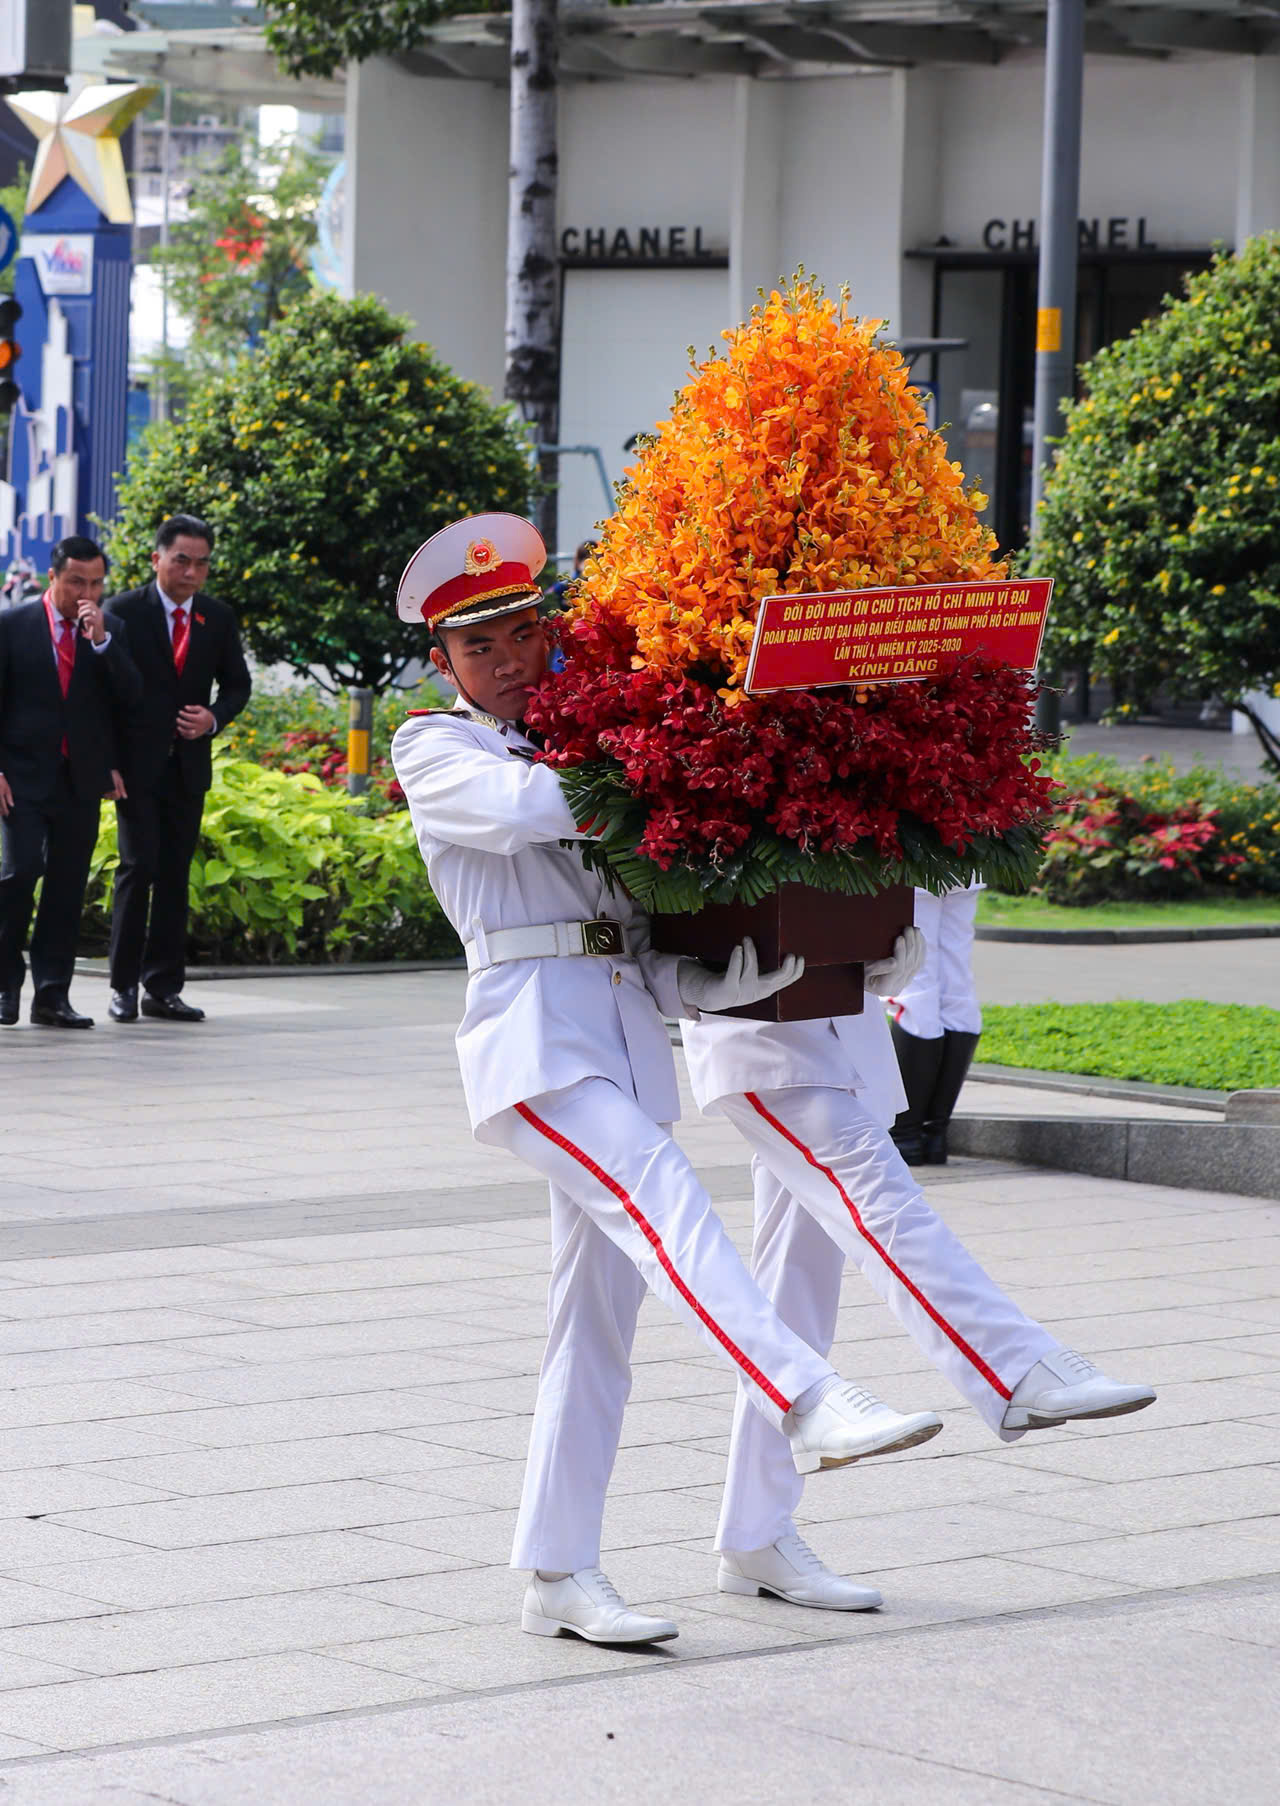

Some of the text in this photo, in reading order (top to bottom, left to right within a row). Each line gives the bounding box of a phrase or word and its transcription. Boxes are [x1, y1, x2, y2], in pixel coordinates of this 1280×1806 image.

[561, 226, 713, 257] CHANEL
[983, 217, 1157, 251] CHNEL
[783, 602, 804, 621] ĐỜI
[805, 600, 826, 620] ĐỜI
[826, 598, 853, 618] NHỚ
[853, 598, 870, 616] ƠN
[871, 593, 895, 615] CHỦ
[897, 596, 923, 616] TỊCH
[943, 590, 965, 609] CHÍ
[964, 591, 995, 608] MINH
[997, 587, 1011, 606] VĨ
[1010, 589, 1031, 608] ĐẠI
[762, 626, 787, 645] ĐOÀN
[786, 628, 802, 646] ĐẠI
[836, 624, 852, 641] ĐẠI
[852, 619, 868, 640] HỘI
[868, 621, 884, 639] ĐẠI
[905, 615, 928, 633] ĐẢNG
[928, 614, 941, 634] BỘ
[942, 612, 970, 631] THÀNH
[970, 609, 990, 629] PHỐ
[1002, 609, 1019, 627] CHÍ
[1018, 611, 1042, 626] MINH
[852, 641, 870, 659] THỨ
[877, 639, 905, 659] NHIỆM
[917, 637, 962, 654] 2025-2030
[849, 658, 938, 677] KÍNH DÂNG
